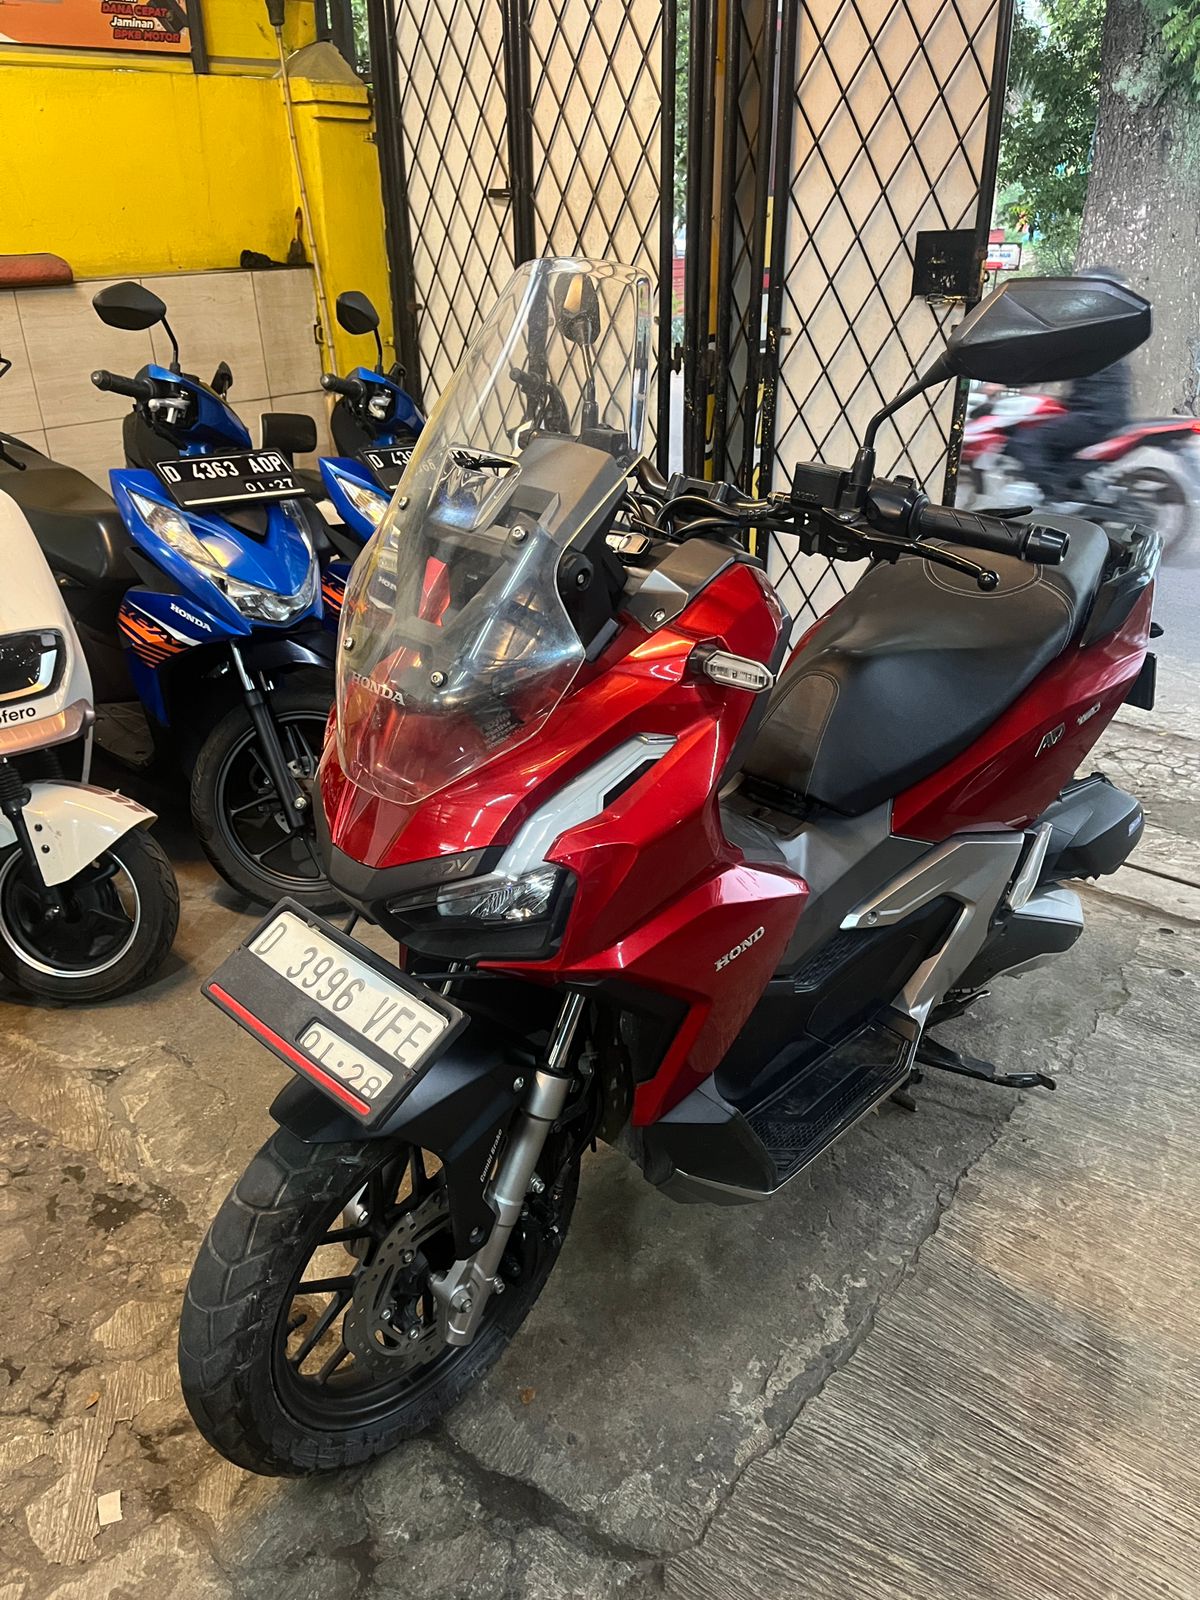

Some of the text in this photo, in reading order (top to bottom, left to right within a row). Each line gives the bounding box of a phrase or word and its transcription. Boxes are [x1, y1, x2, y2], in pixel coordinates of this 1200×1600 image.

[102, 4, 167, 17] DANA CEPAT
[111, 17, 153, 29] Jaminan
[114, 29, 180, 42] BPKB MOTOR
[368, 454, 384, 469] D
[163, 466, 182, 482] D
[192, 461, 239, 480] 4363
[170, 602, 213, 633] HONDA
[351, 671, 406, 706] HONDA
[0, 707, 36, 723] fero
[253, 921, 432, 1063] D 3996 VFE
[480, 1128, 503, 1182] Combi Brake
